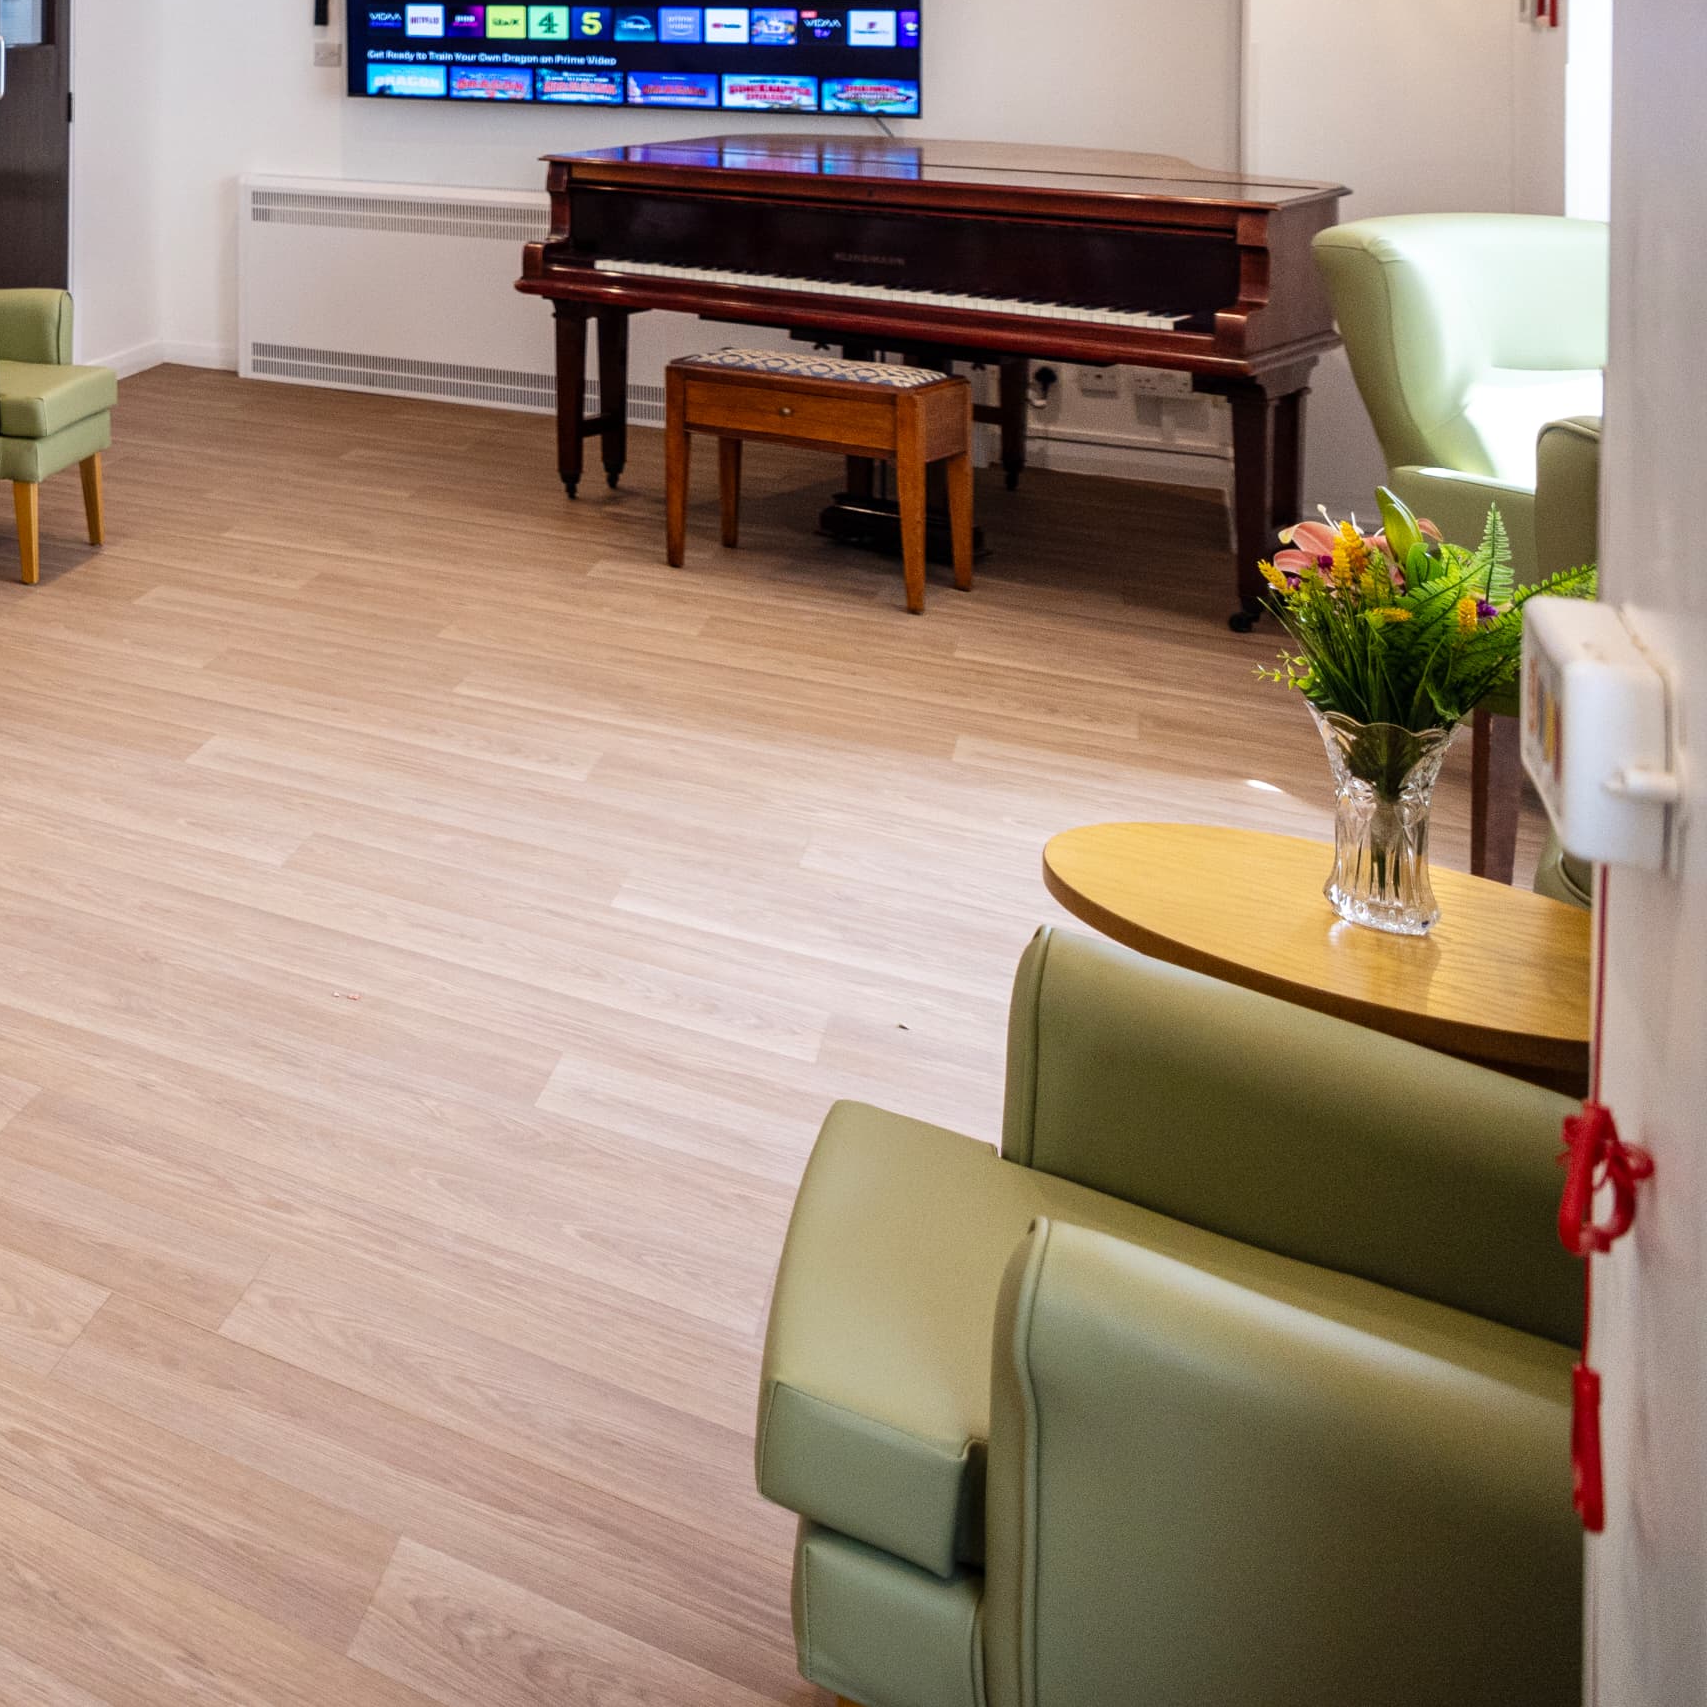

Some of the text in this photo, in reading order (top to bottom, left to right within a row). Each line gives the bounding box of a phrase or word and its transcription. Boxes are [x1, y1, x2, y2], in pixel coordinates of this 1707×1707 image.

[537, 11, 559, 35] 4
[580, 11, 603, 36] 5
[367, 49, 617, 66] Get Ready to Train Your Own Dragon on Prime Video
